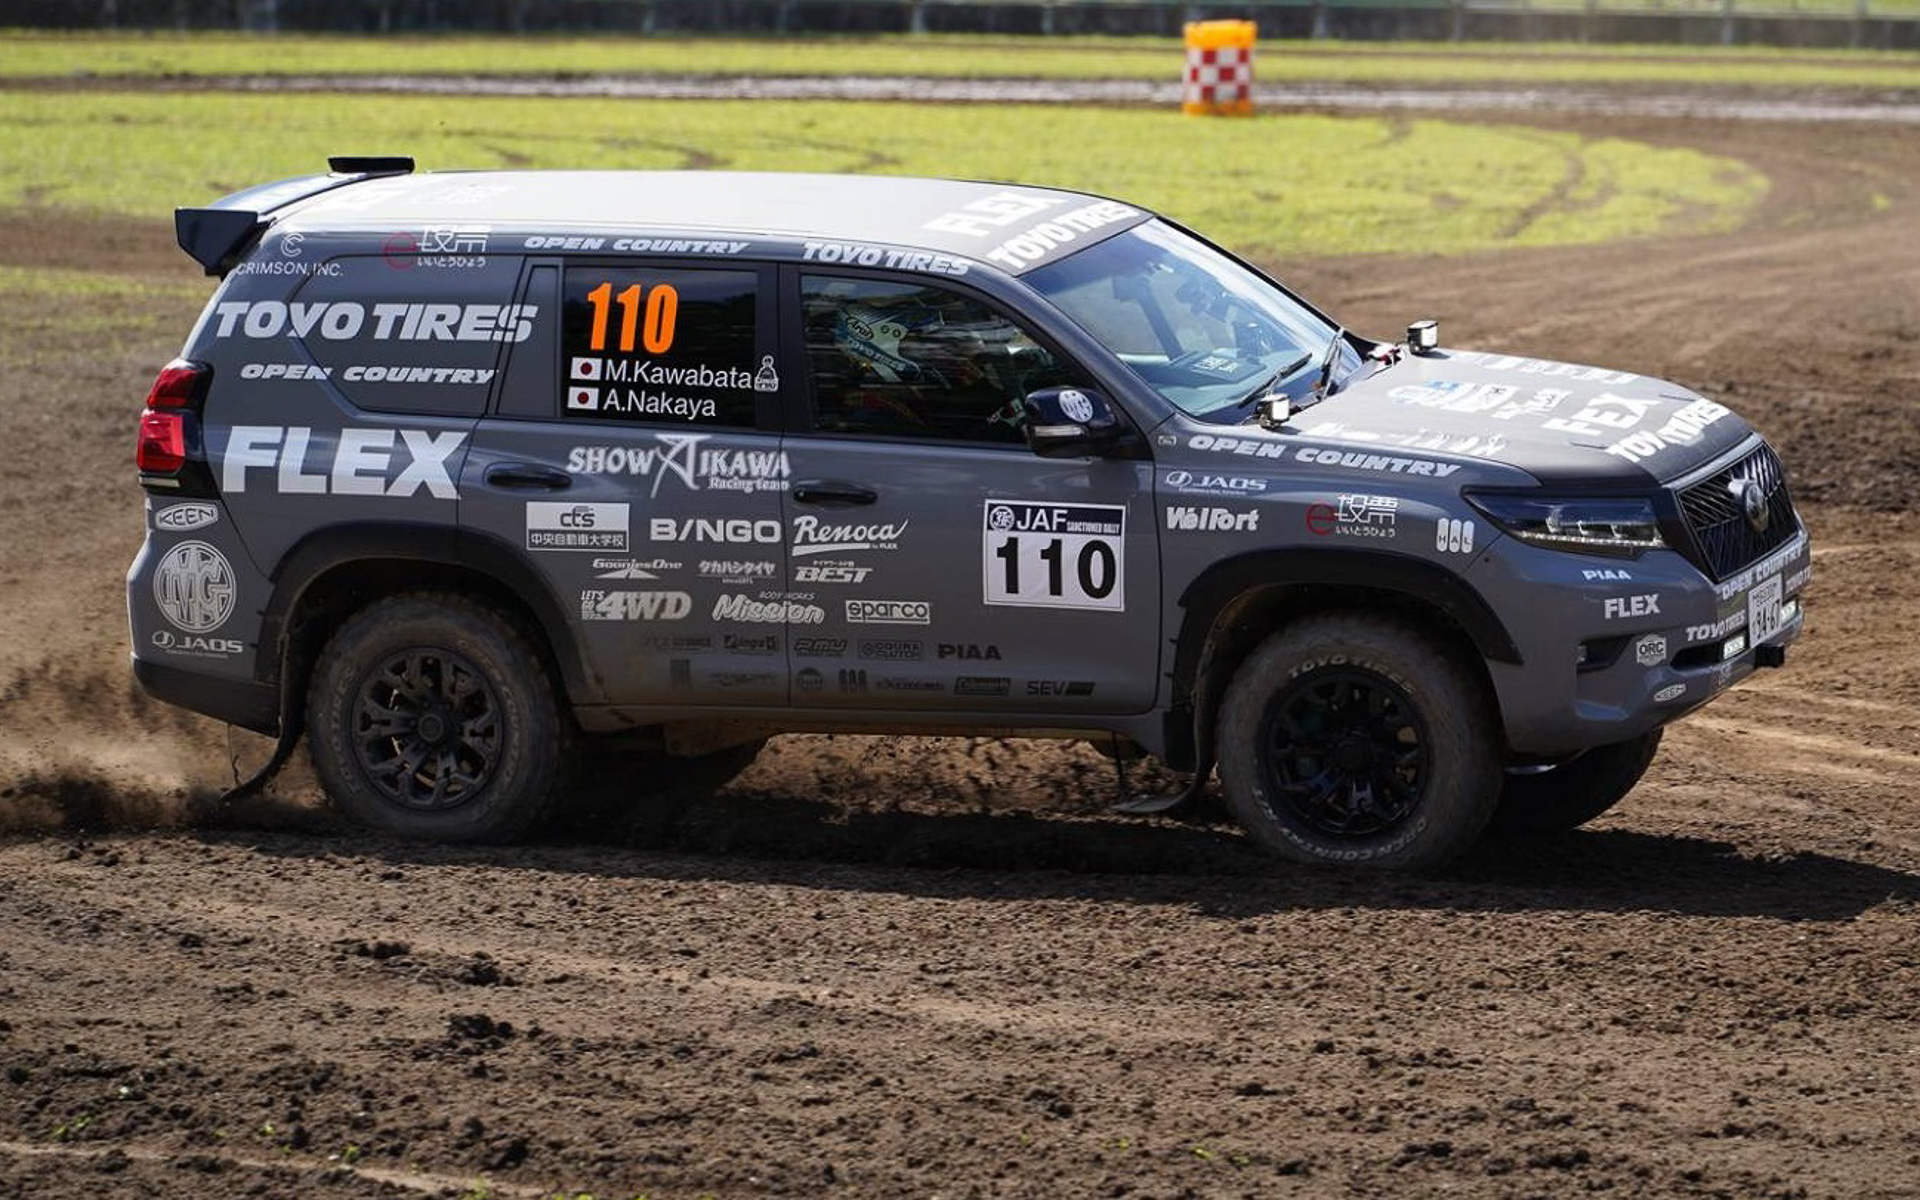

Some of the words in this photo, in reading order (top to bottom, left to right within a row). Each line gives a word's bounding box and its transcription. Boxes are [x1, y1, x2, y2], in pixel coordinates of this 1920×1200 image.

[524, 235, 602, 251] OPEN
[612, 237, 750, 255] COUNTRY
[985, 221, 1077, 269] TOYO
[803, 241, 882, 266] TOYO
[886, 249, 975, 276] TIRES
[216, 301, 365, 339] TOYO
[373, 303, 541, 343] TIRES
[586, 281, 679, 355] 110
[240, 363, 332, 381] OPEN
[343, 365, 499, 385] COUNTRY
[604, 358, 753, 390] M.Kawabata
[602, 391, 717, 420] A.Nakaya
[222, 425, 470, 501] FLEX
[565, 446, 652, 476] SHOW
[1188, 435, 1287, 459] OPEN
[1294, 447, 1463, 478] COUNTRY
[708, 477, 754, 493] Racing
[756, 477, 790, 491] team
[1192, 475, 1268, 491] JAOS
[158, 505, 215, 527] KEEN
[560, 506, 596, 528] cts
[1016, 507, 1068, 532] JAF
[793, 514, 909, 545] Renoca
[795, 566, 873, 584] BEST
[996, 536, 1117, 600] 110
[1582, 569, 1633, 581] PIAA
[596, 591, 692, 621] 4WD
[711, 594, 825, 624] Mission
[848, 603, 929, 620] sparco
[1604, 593, 1661, 620] FLEX
[176, 636, 244, 653] JAOS
[938, 643, 1002, 661] PIAA
[1638, 641, 1664, 655] ORC
[1287, 653, 1348, 679] TOYO
[1025, 680, 1066, 697] SEV
